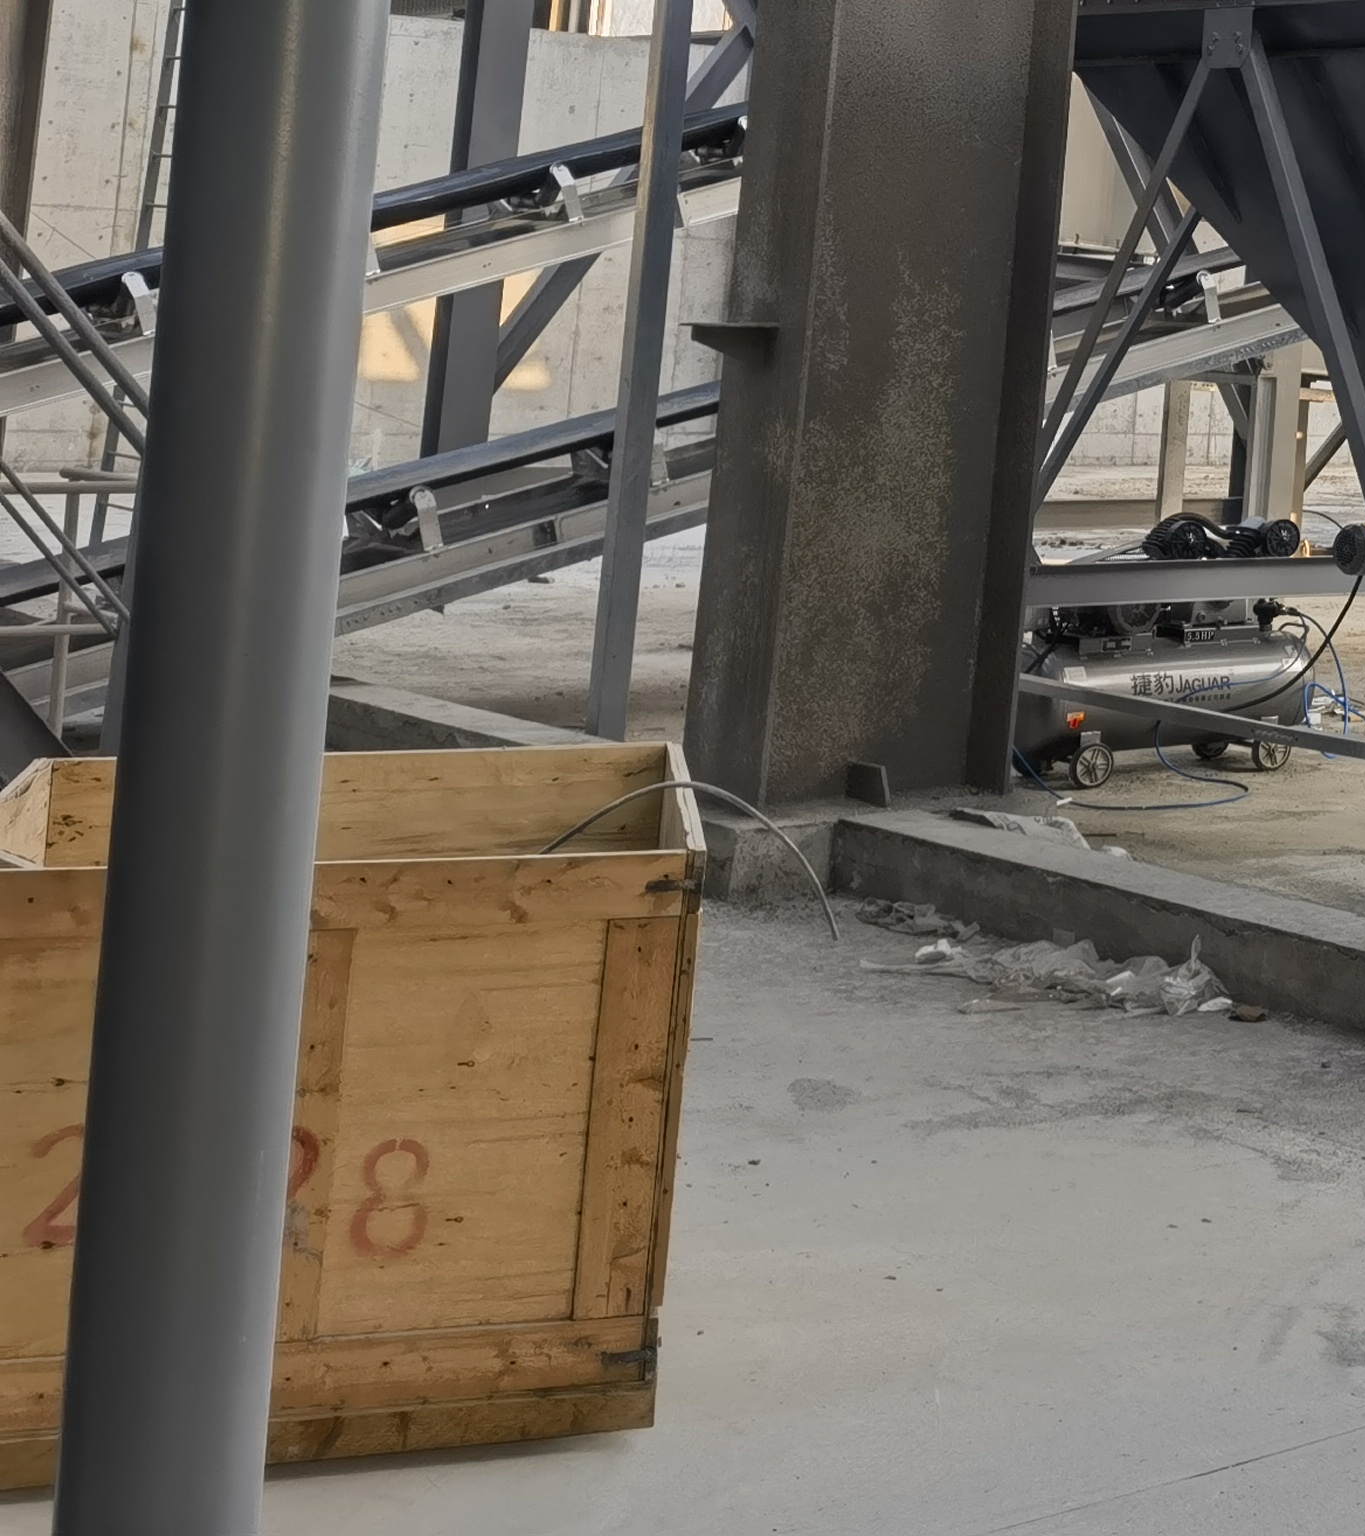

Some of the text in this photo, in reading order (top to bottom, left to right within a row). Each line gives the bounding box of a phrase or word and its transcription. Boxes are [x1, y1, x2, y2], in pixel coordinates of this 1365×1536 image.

[1186, 630, 1215, 642] 5.5HP
[1129, 672, 1231, 696] 捷豹 JAGUAR
